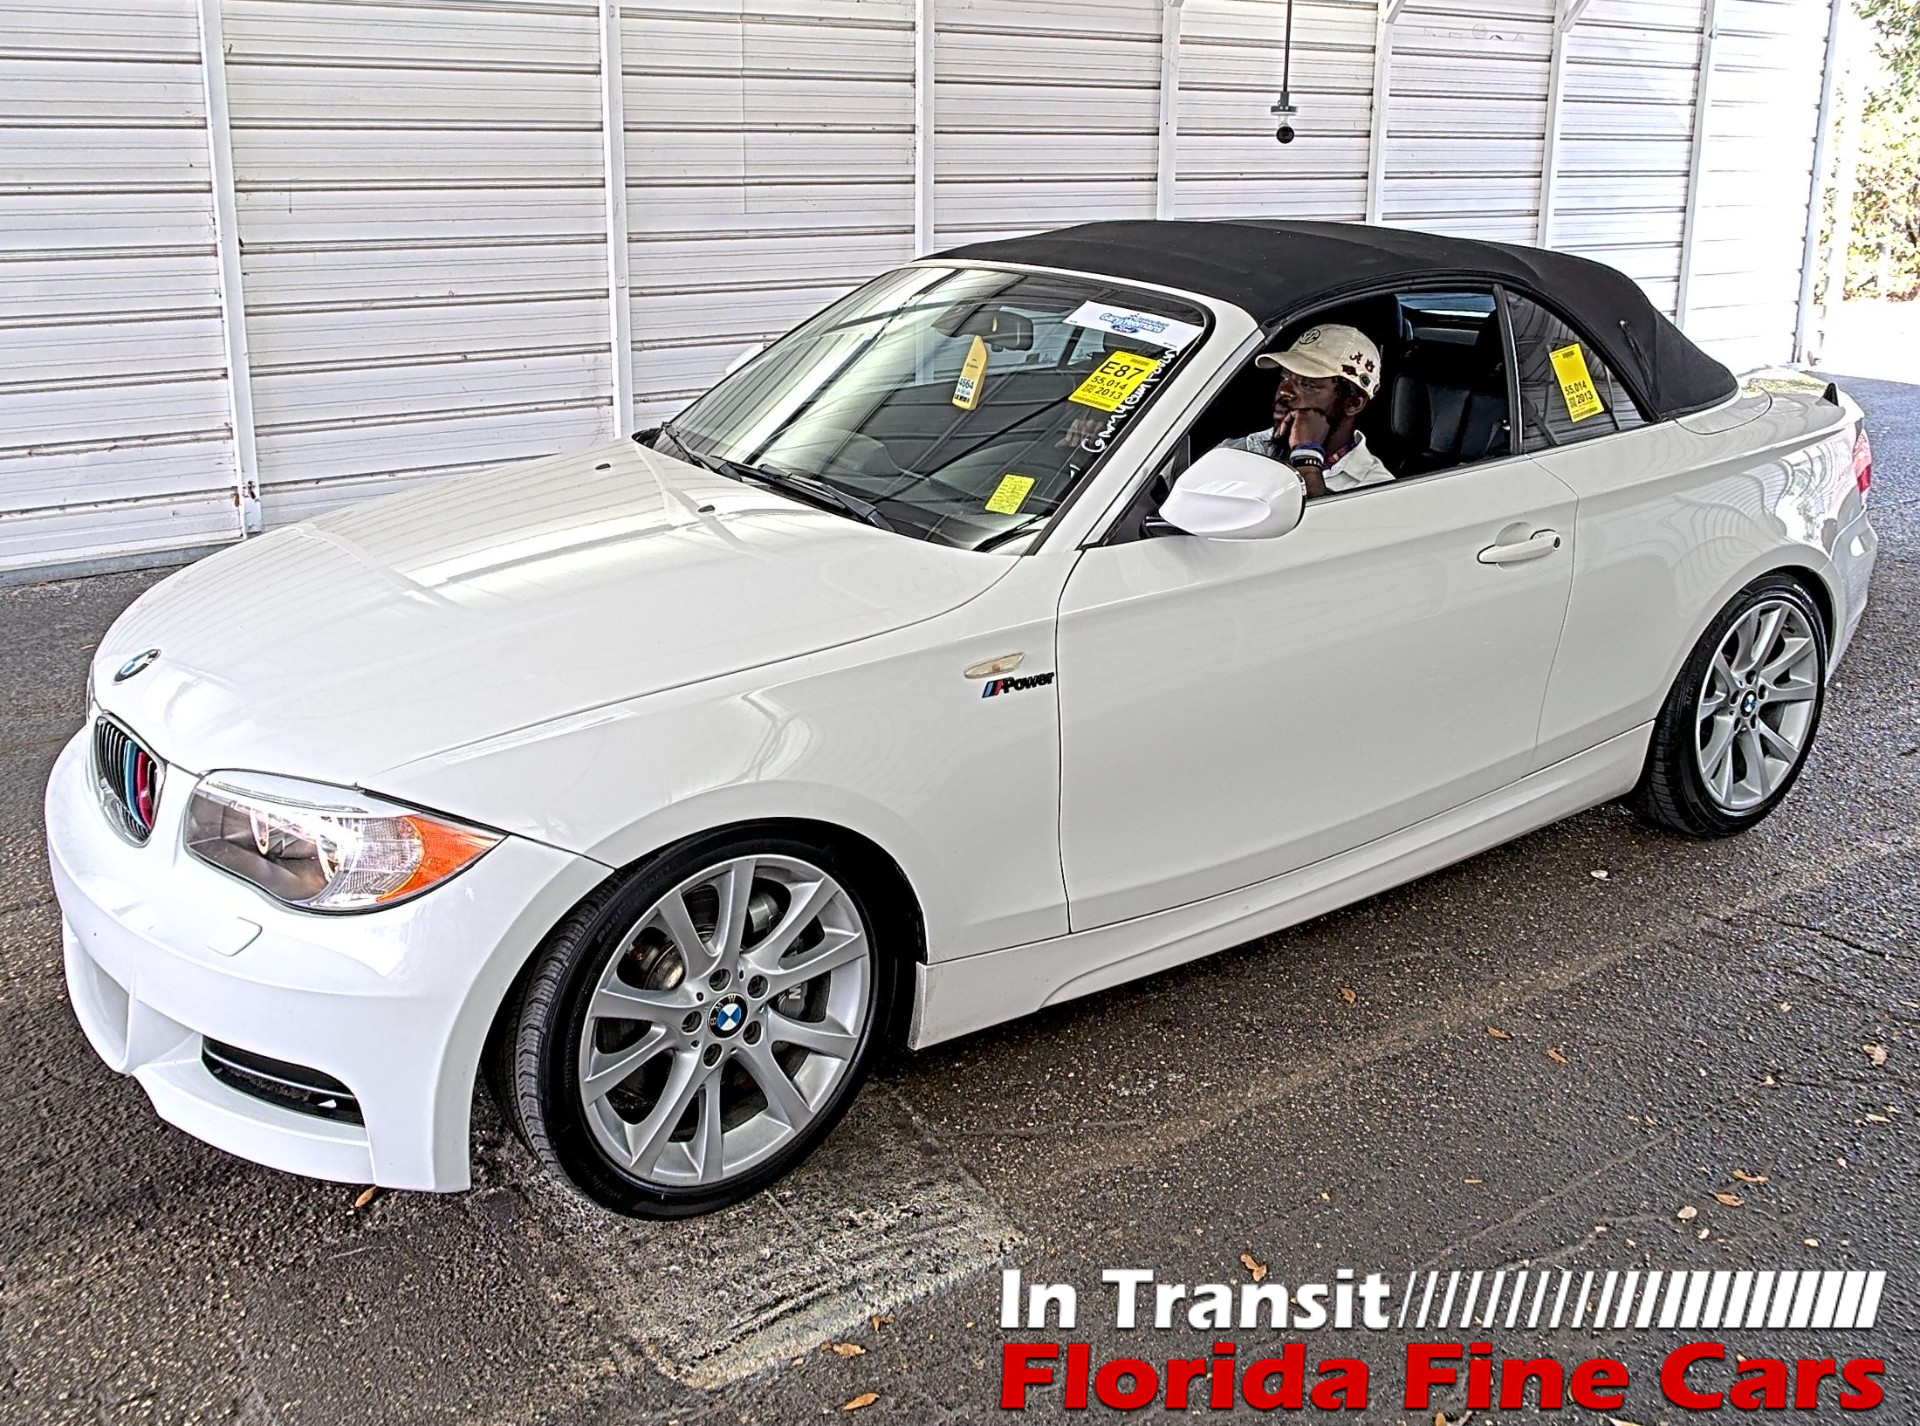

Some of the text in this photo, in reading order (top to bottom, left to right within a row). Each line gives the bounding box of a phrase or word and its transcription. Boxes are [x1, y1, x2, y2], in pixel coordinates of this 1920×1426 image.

[1099, 361, 1145, 381] E87
[1095, 387, 1123, 401] 2013
[1576, 389, 1594, 405] 2013
